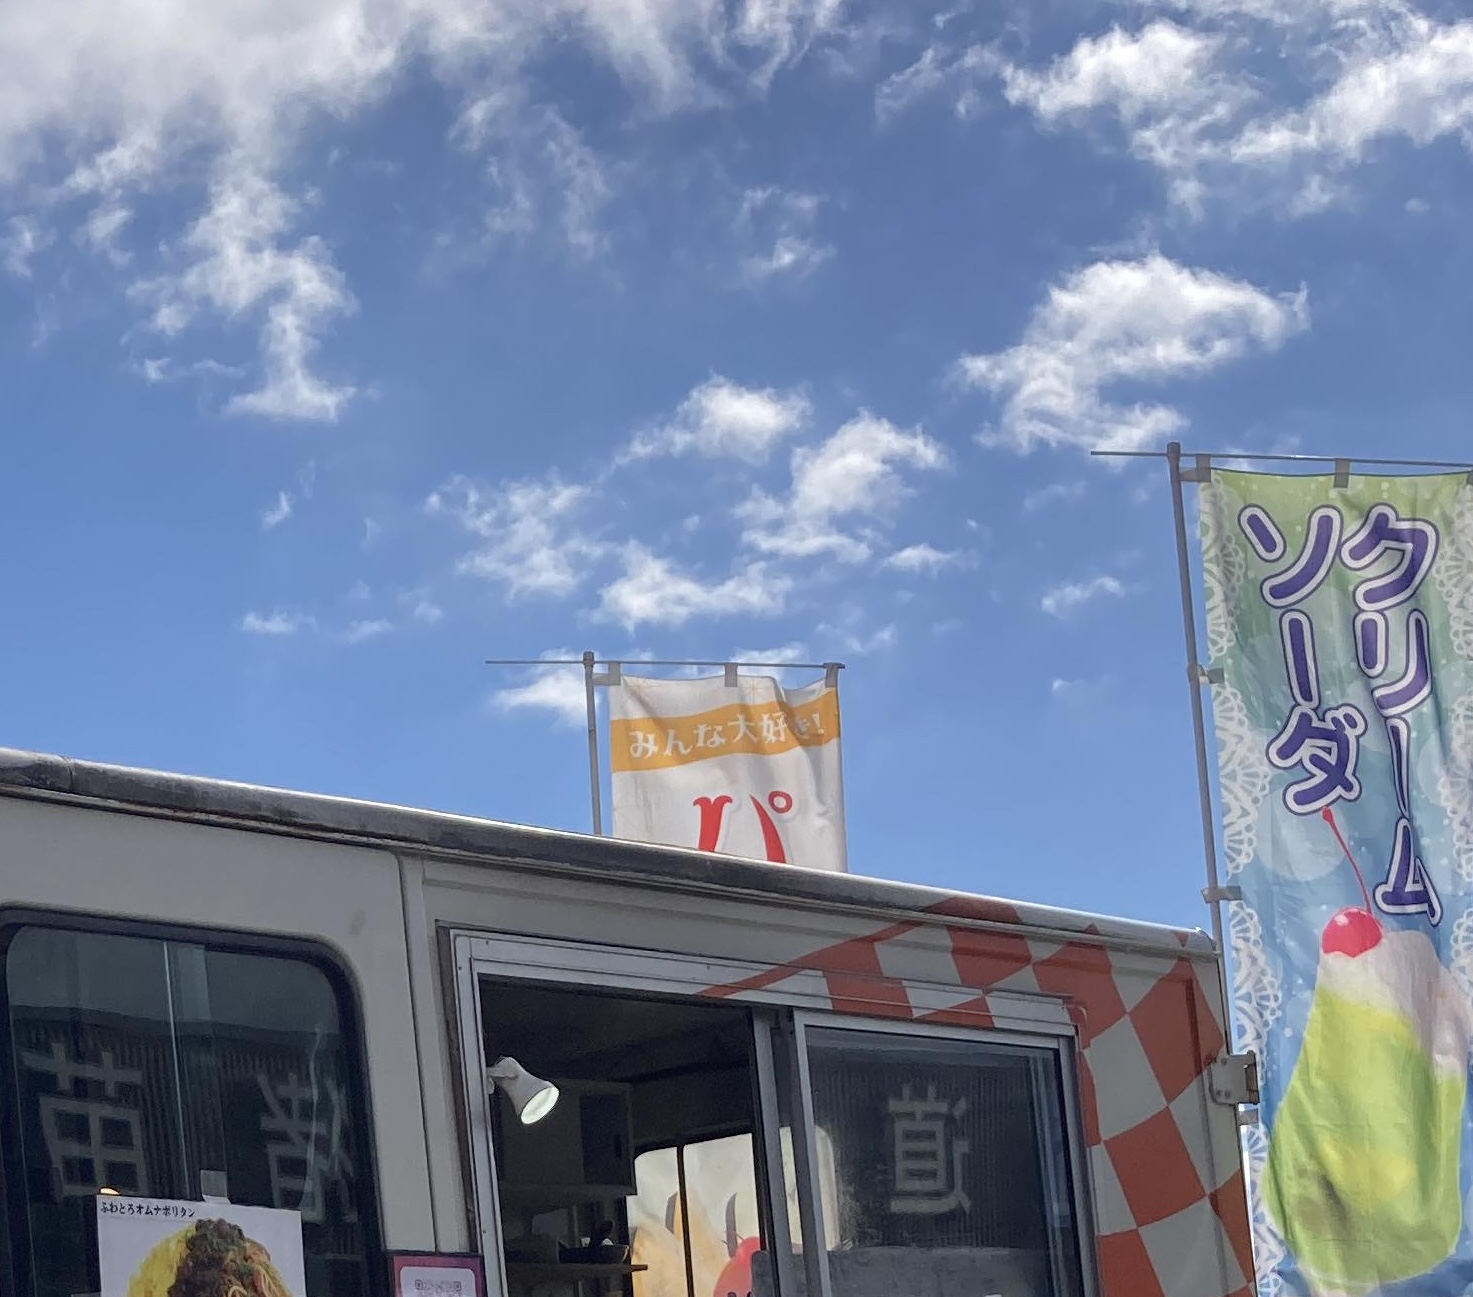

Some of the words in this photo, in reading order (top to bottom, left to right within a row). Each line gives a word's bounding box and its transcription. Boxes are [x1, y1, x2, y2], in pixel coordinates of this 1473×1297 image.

[1238, 505, 1366, 815] ソーダ
[1340, 504, 1442, 926] クリーム
[100, 1201, 196, 1219] ふわとろオムナポリタン
